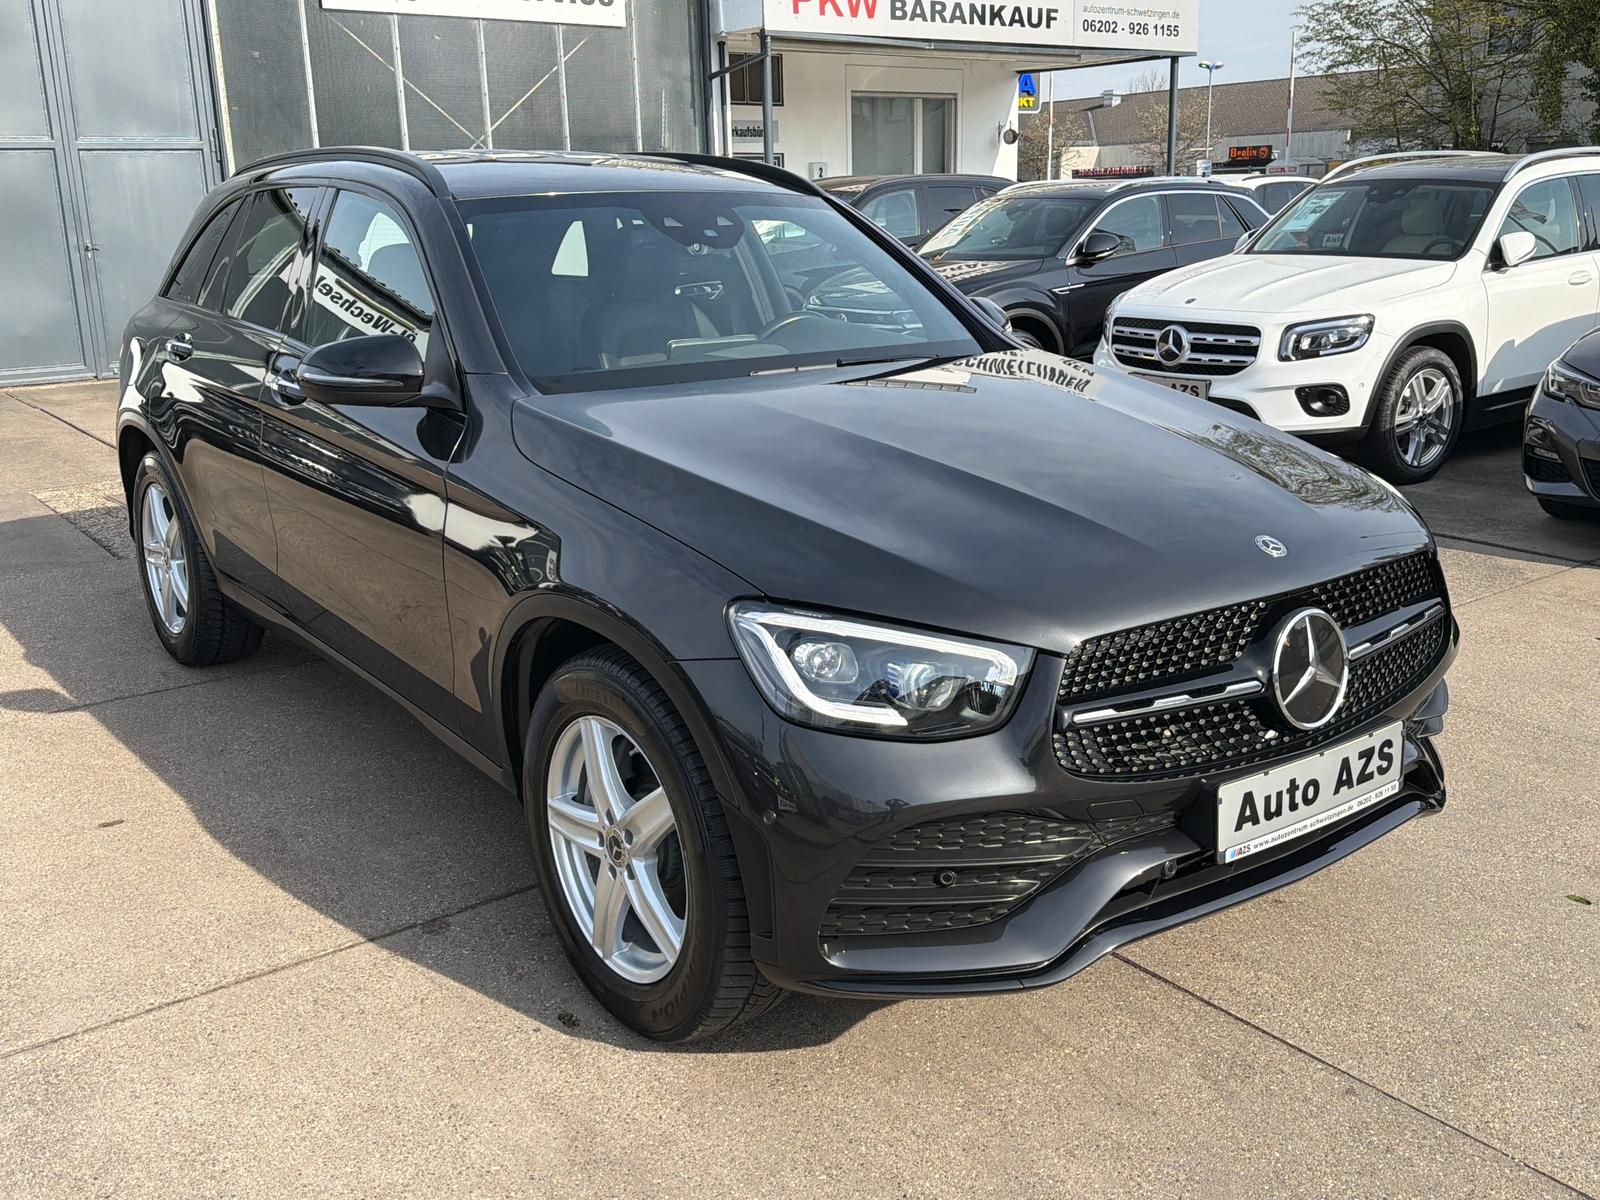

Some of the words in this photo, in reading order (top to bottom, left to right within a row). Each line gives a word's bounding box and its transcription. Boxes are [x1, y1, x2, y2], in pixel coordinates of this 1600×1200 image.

[889, 0, 1059, 29] BARANKAUF
[1082, 4, 1180, 20] autozentrum-schwetzingen.de
[1082, 19, 1118, 33] 06202
[1128, 22, 1149, 35] 926
[1153, 24, 1180, 37] 1155
[1018, 97, 1035, 107] KT
[818, 167, 823, 178] 2
[1234, 777, 1320, 832] Auto
[1333, 739, 1394, 796] AZS
